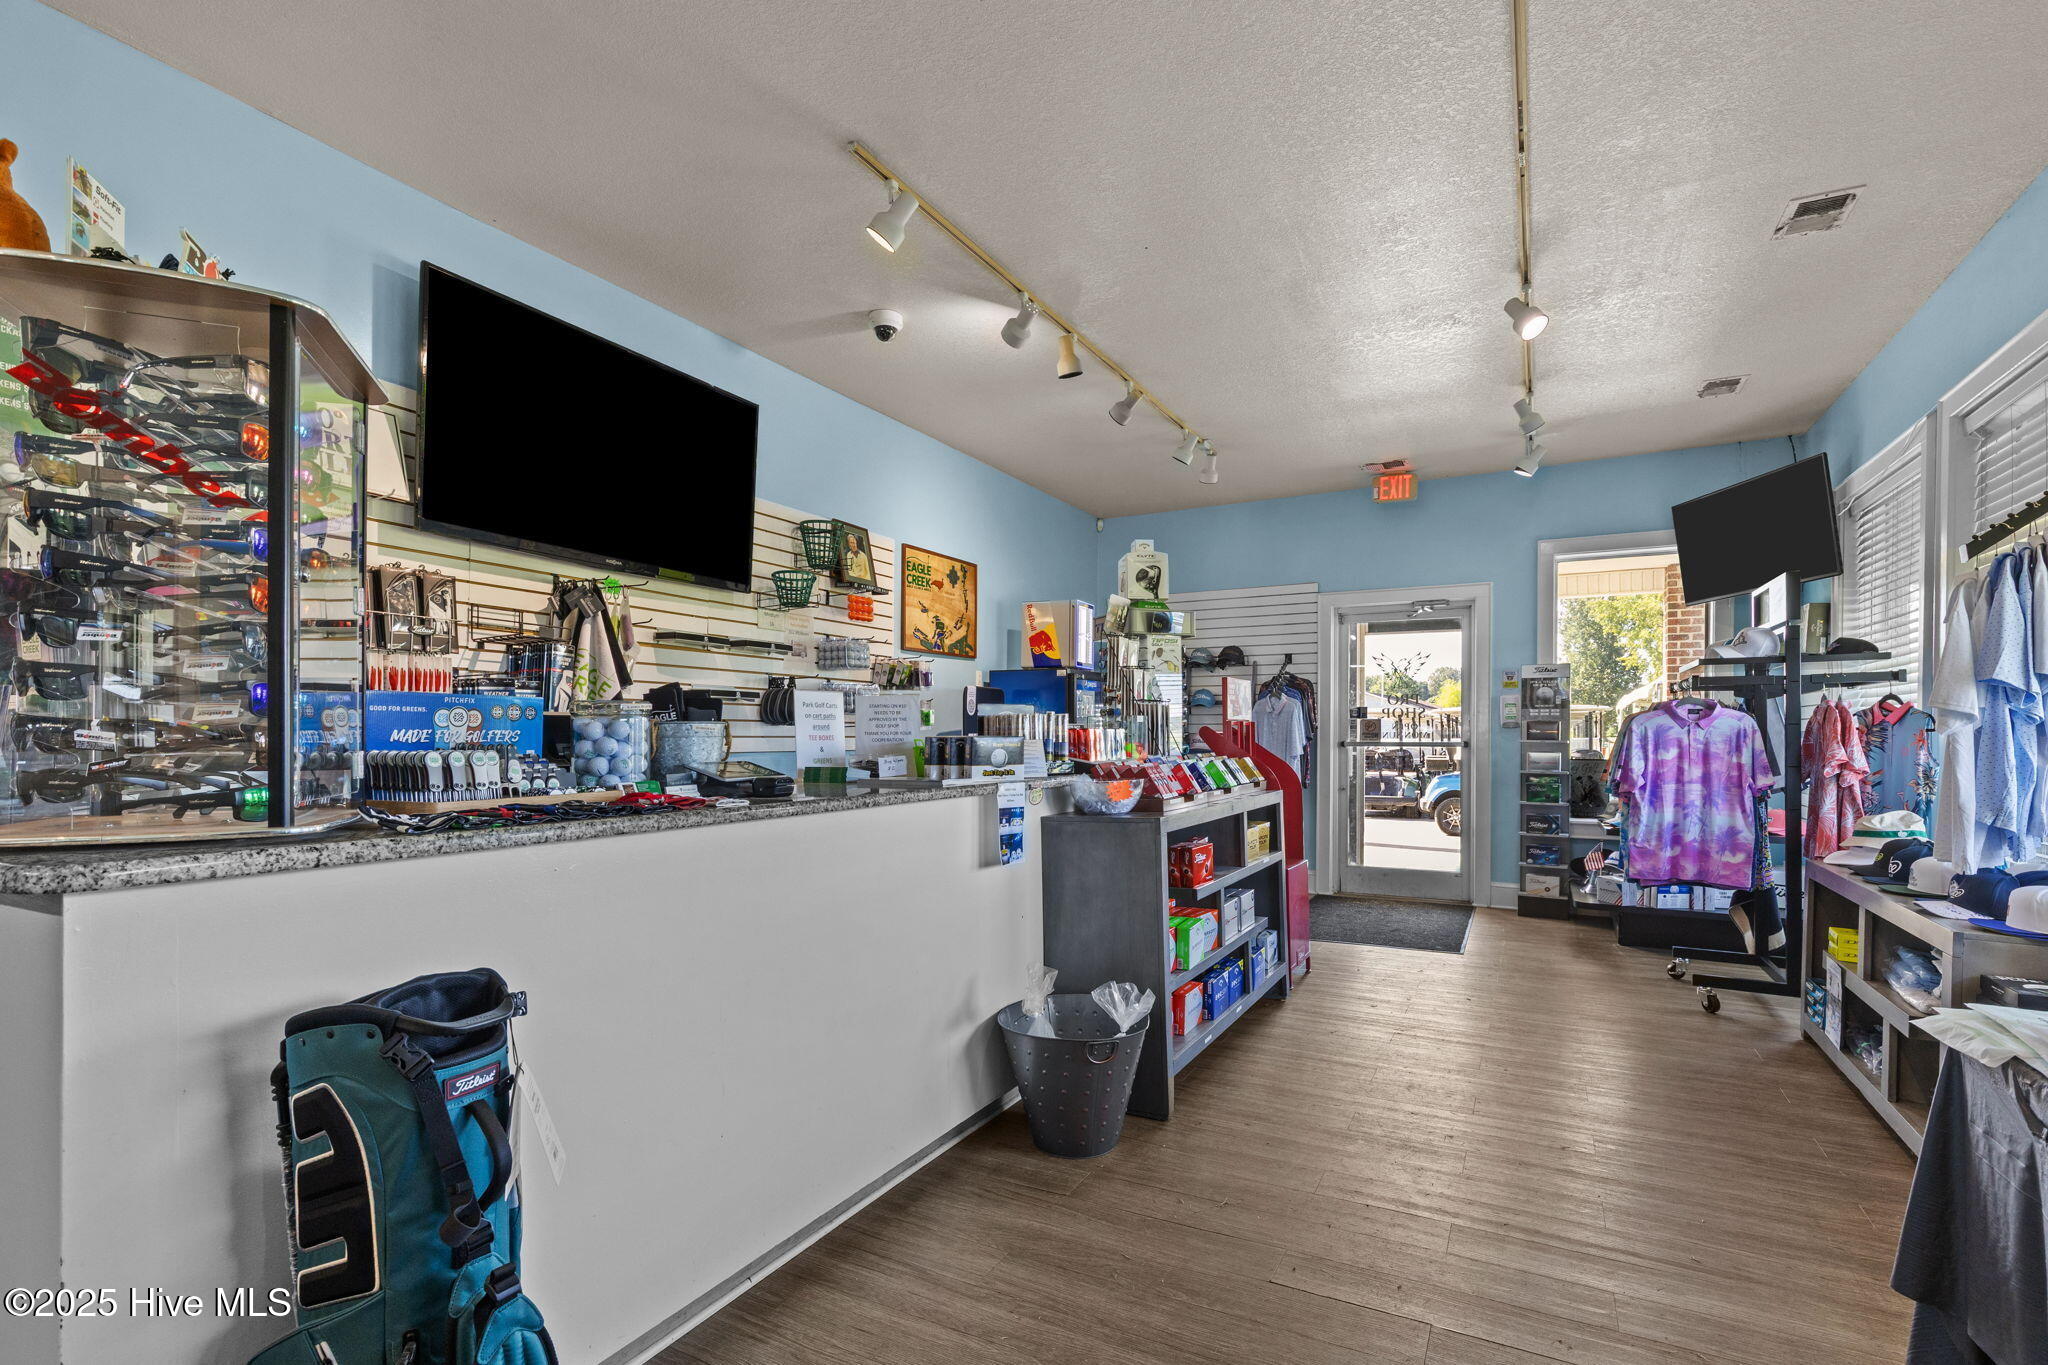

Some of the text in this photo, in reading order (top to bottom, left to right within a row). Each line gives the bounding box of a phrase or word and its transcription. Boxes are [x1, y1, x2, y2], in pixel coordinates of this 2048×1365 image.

[96, 186, 122, 216] Soft-Fit
[1380, 474, 1413, 500] EXIT
[906, 560, 932, 576] EAGLE
[906, 574, 932, 588] CREEK
[444, 696, 476, 704] PITCHFIX
[390, 729, 521, 744] MADE FOR GOLFERS
[452, 1070, 495, 1096] Titleist
